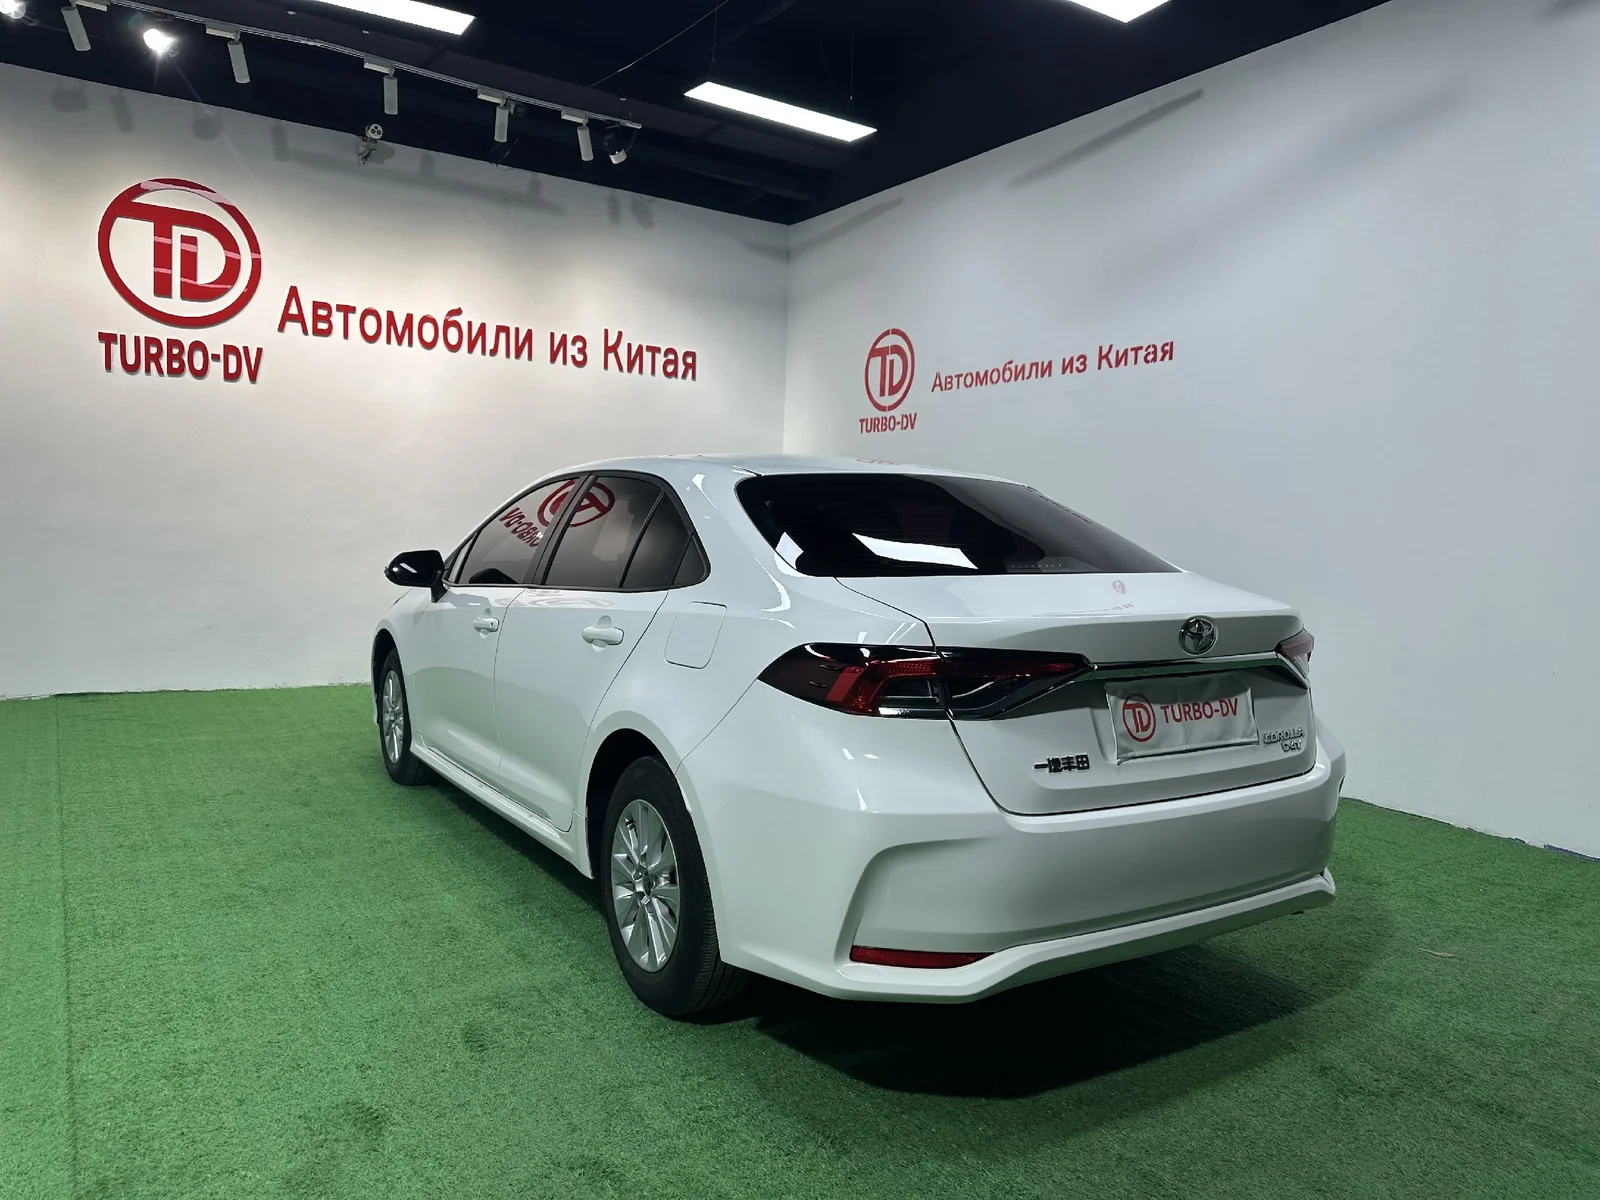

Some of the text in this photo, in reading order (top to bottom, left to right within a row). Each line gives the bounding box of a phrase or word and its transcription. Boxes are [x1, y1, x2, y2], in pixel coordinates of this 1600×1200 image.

[277, 285, 697, 381] Автомобили из Китая
[98, 331, 263, 383] TURBO-DV
[931, 341, 1174, 393] Автомобили из Китая
[858, 412, 917, 434] TURBO-DV
[1160, 698, 1238, 724] TURBO-DV
[1263, 727, 1305, 745] COROLLA
